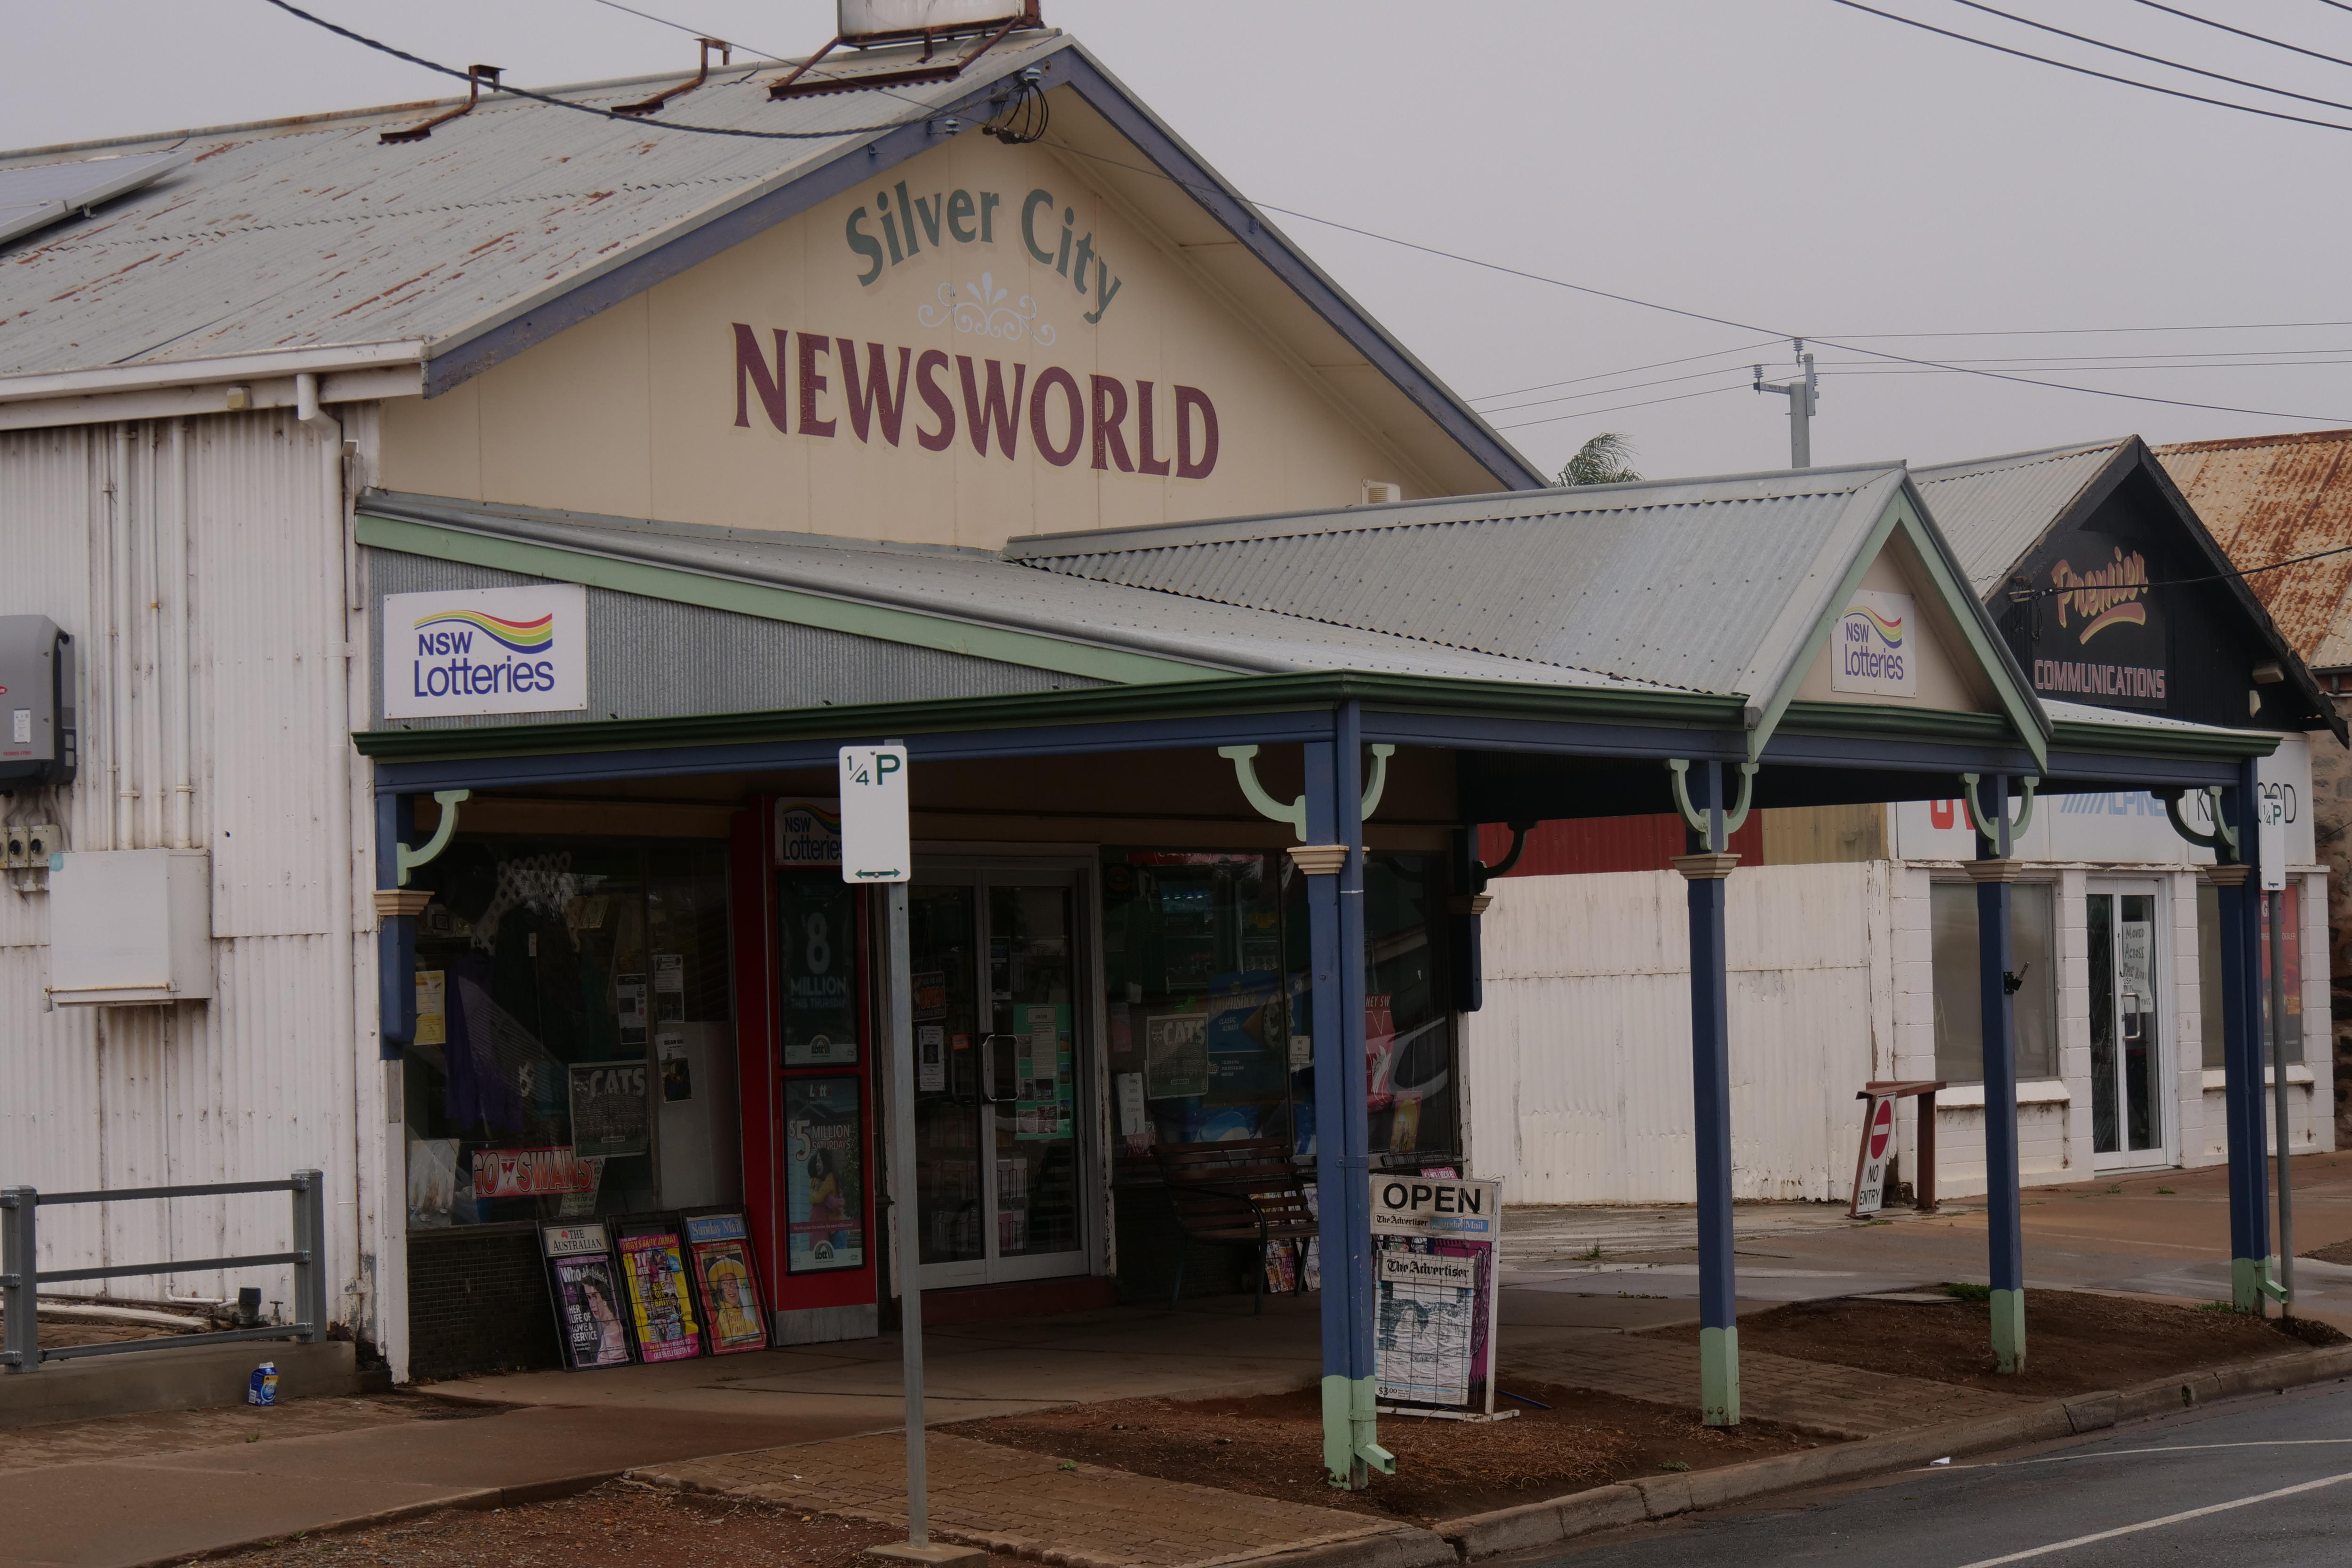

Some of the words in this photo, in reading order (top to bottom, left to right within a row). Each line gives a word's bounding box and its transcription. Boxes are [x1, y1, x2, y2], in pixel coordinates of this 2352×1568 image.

[845, 180, 999, 287] Silver
[1021, 188, 1122, 325] City
[731, 322, 1219, 480] NEWSWORLD
[2050, 546, 2149, 629] Premier
[1846, 622, 1869, 643] NSW
[418, 631, 473, 656] NSW
[1844, 643, 1904, 681] Lotteries
[413, 655, 555, 697] Lotteries
[2034, 659, 2165, 699] COMMUNICATIONS
[876, 754, 901, 786] P
[2273, 804, 2282, 826] P
[785, 817, 811, 833] NSW
[2125, 925, 2145, 939] MOVED
[2124, 943, 2145, 959] ACROSS
[790, 975, 847, 996] MILLION
[791, 998, 808, 1009] THIS
[810, 997, 846, 1009] THURSDAY
[1163, 1020, 1206, 1047] CATS
[589, 1067, 646, 1098] CATS
[809, 1084, 832, 1098] Lotto
[811, 1124, 850, 1138] MILLION
[789, 1119, 811, 1162] $5
[812, 1139, 851, 1151] SATURDAYS
[472, 1152, 499, 1194] GO
[516, 1149, 592, 1192] SWANS
[1867, 1164, 1879, 1184] NO
[1383, 1182, 1481, 1214] OPEN
[1859, 1188, 1881, 1206] ENTRY
[691, 1221, 721, 1238] Sunday
[722, 1219, 742, 1234] Mail
[1376, 1214, 1390, 1224] The
[1391, 1216, 1429, 1226] Advertiser
[1440, 1220, 1464, 1230] unday
[1465, 1220, 1484, 1230] Mail
[568, 1229, 585, 1240] THE
[553, 1238, 602, 1252] AUSTRALIAN
[635, 1252, 647, 1267] TV
[559, 1266, 582, 1283] Who
[1386, 1260, 1408, 1273] The
[1410, 1262, 1470, 1278] Advertiser
[568, 1304, 581, 1314] HER
[571, 1313, 583, 1324] LIFE
[584, 1312, 591, 1321] OF
[572, 1330, 597, 1342] SERVICE
[1378, 1386, 1398, 1396] $3.00
